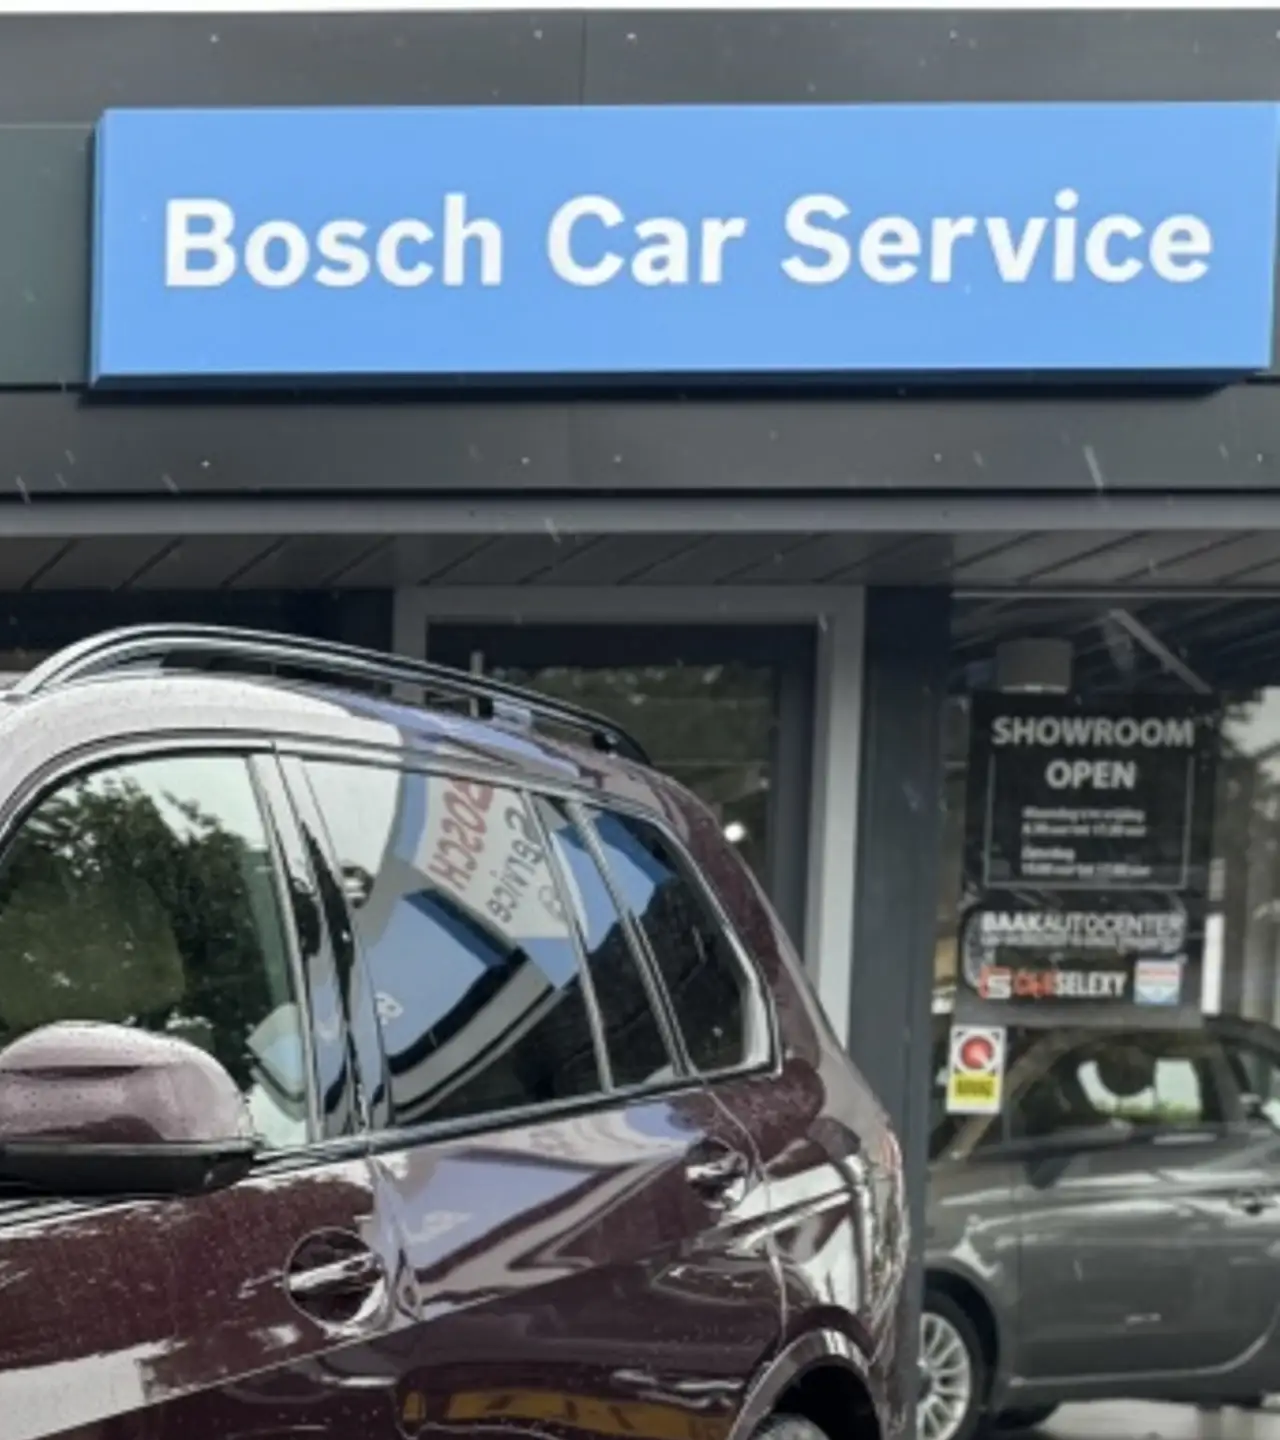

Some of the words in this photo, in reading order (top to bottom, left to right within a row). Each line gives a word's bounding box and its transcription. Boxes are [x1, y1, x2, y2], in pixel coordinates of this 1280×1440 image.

[165, 193, 503, 287] Bosch
[547, 194, 747, 286] Car
[780, 188, 1214, 284] Service
[991, 716, 1195, 747] SHOWROOM
[1045, 758, 1137, 790] OPEN
